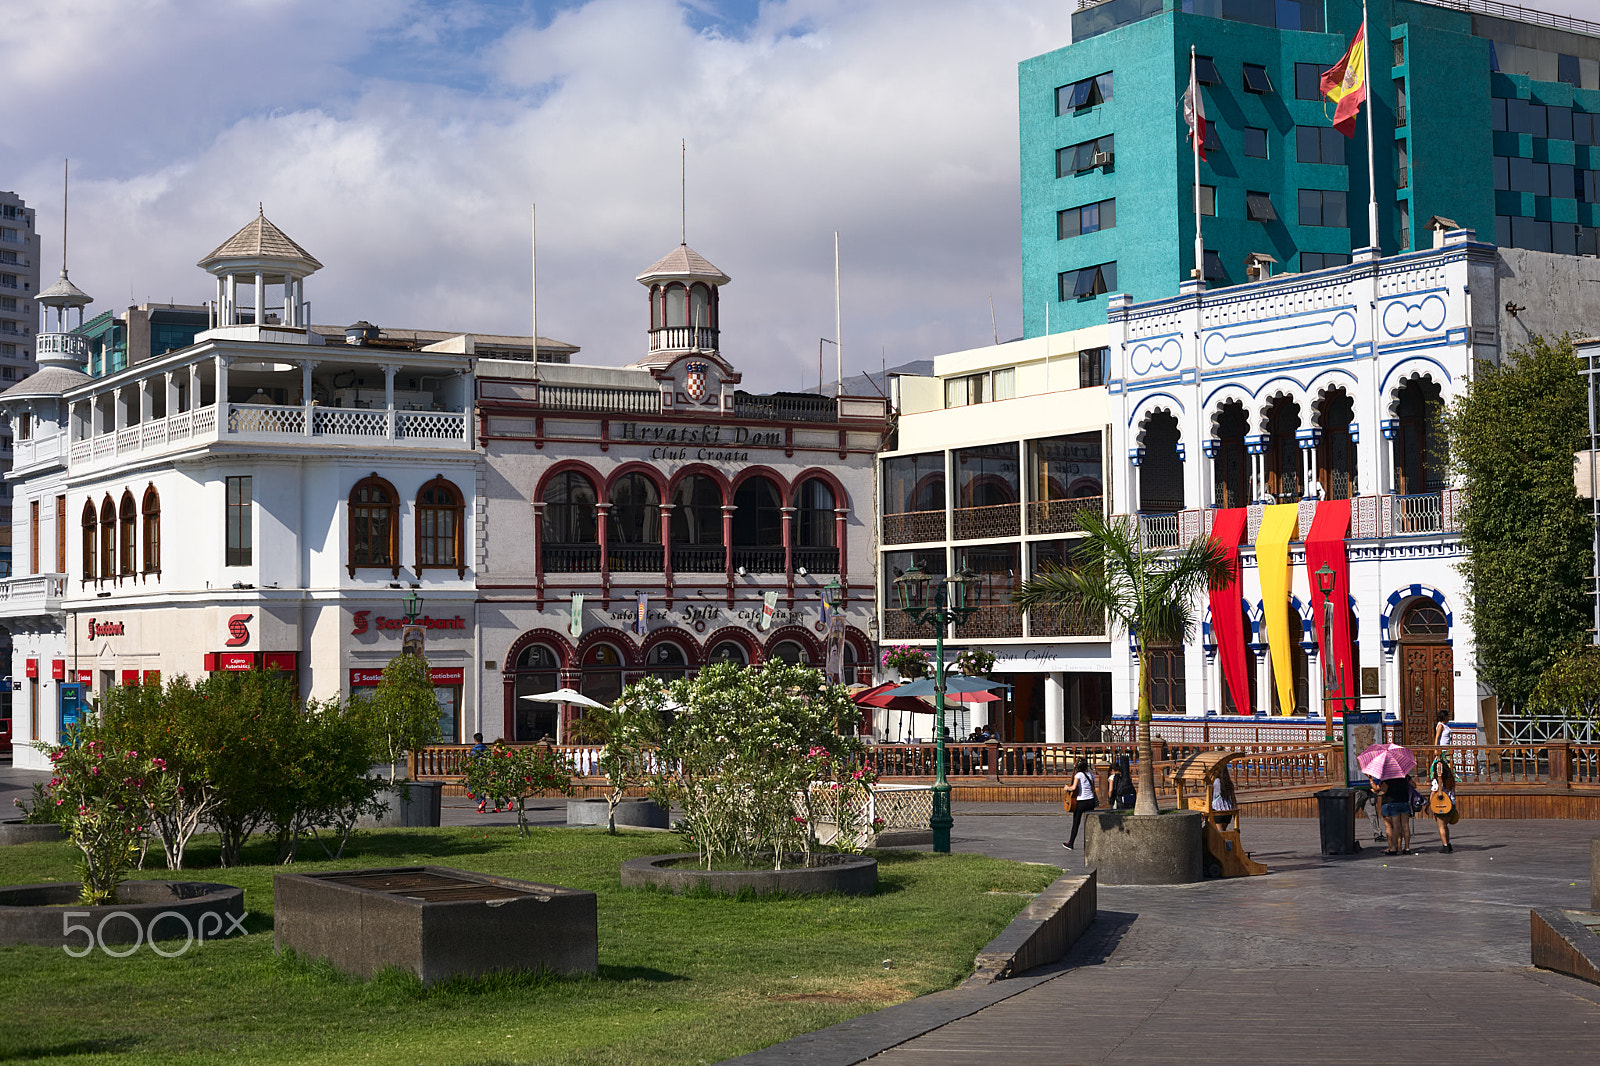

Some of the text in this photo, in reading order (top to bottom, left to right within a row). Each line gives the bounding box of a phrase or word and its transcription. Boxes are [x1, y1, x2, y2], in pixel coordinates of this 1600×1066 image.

[621, 422, 781, 445] Hrvatski Dom
[651, 446, 749, 461] Club Croata
[375, 615, 466, 631] Scotabank
[682, 604, 720, 625] Split
[738, 608, 786, 621] Cafería
[1024, 645, 1058, 668] Coffee
